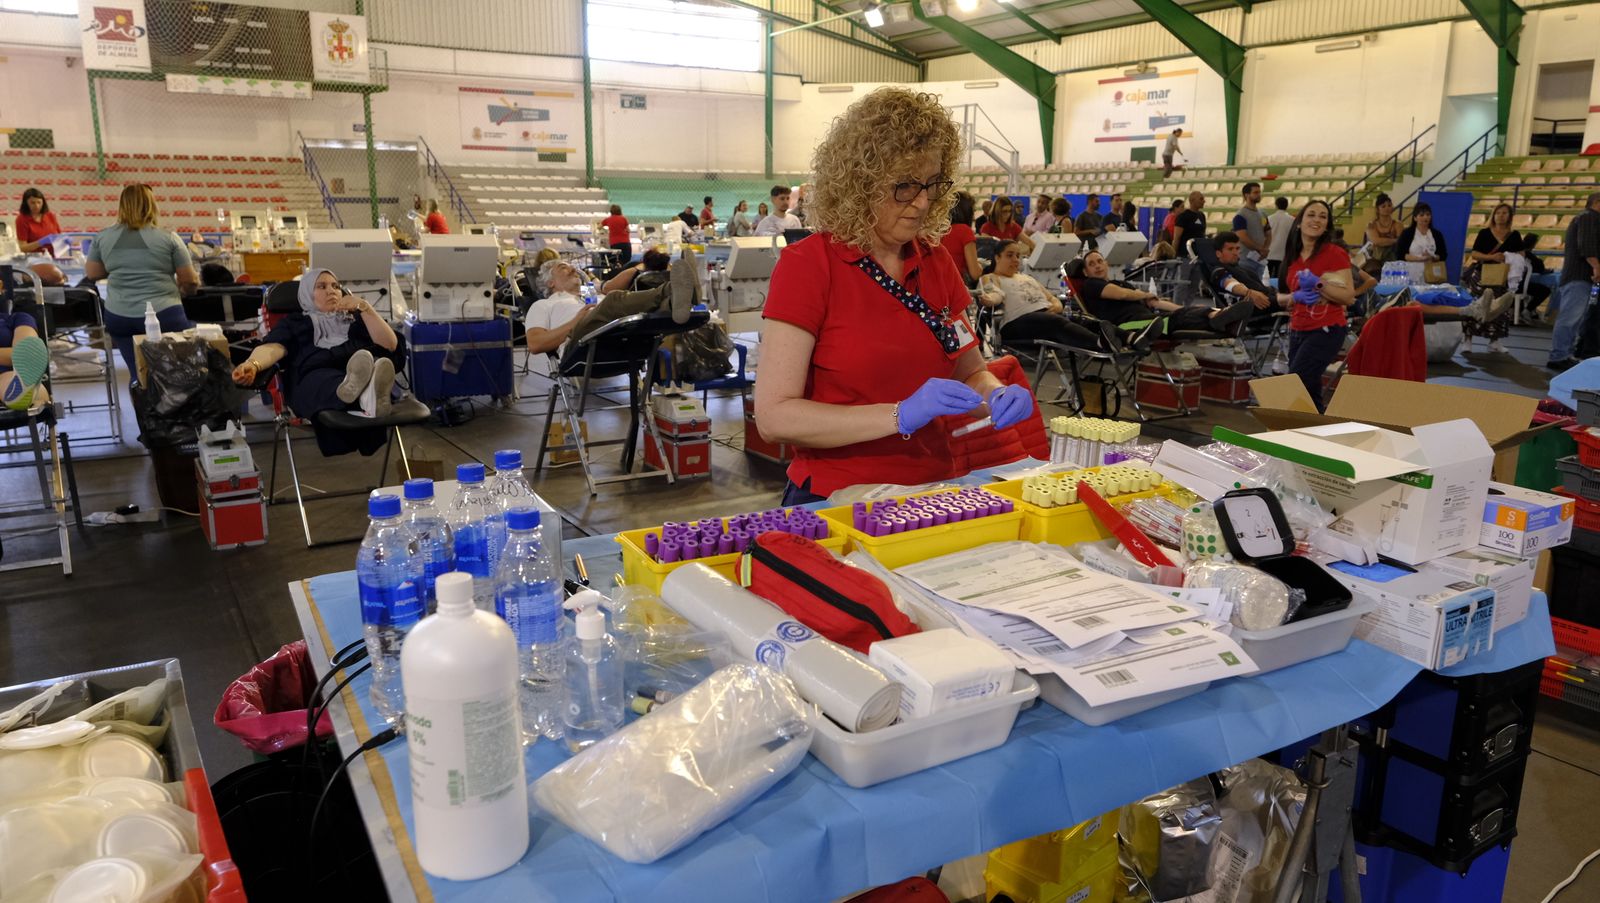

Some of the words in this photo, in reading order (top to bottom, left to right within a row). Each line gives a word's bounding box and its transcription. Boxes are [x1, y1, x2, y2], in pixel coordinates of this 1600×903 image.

[1126, 88, 1171, 105] cajamar
[531, 131, 568, 142] cajamar
[1507, 510, 1516, 521] S
[1498, 530, 1514, 541] 100
[1526, 536, 1539, 549] 100
[1445, 616, 1467, 633] ULTRA
